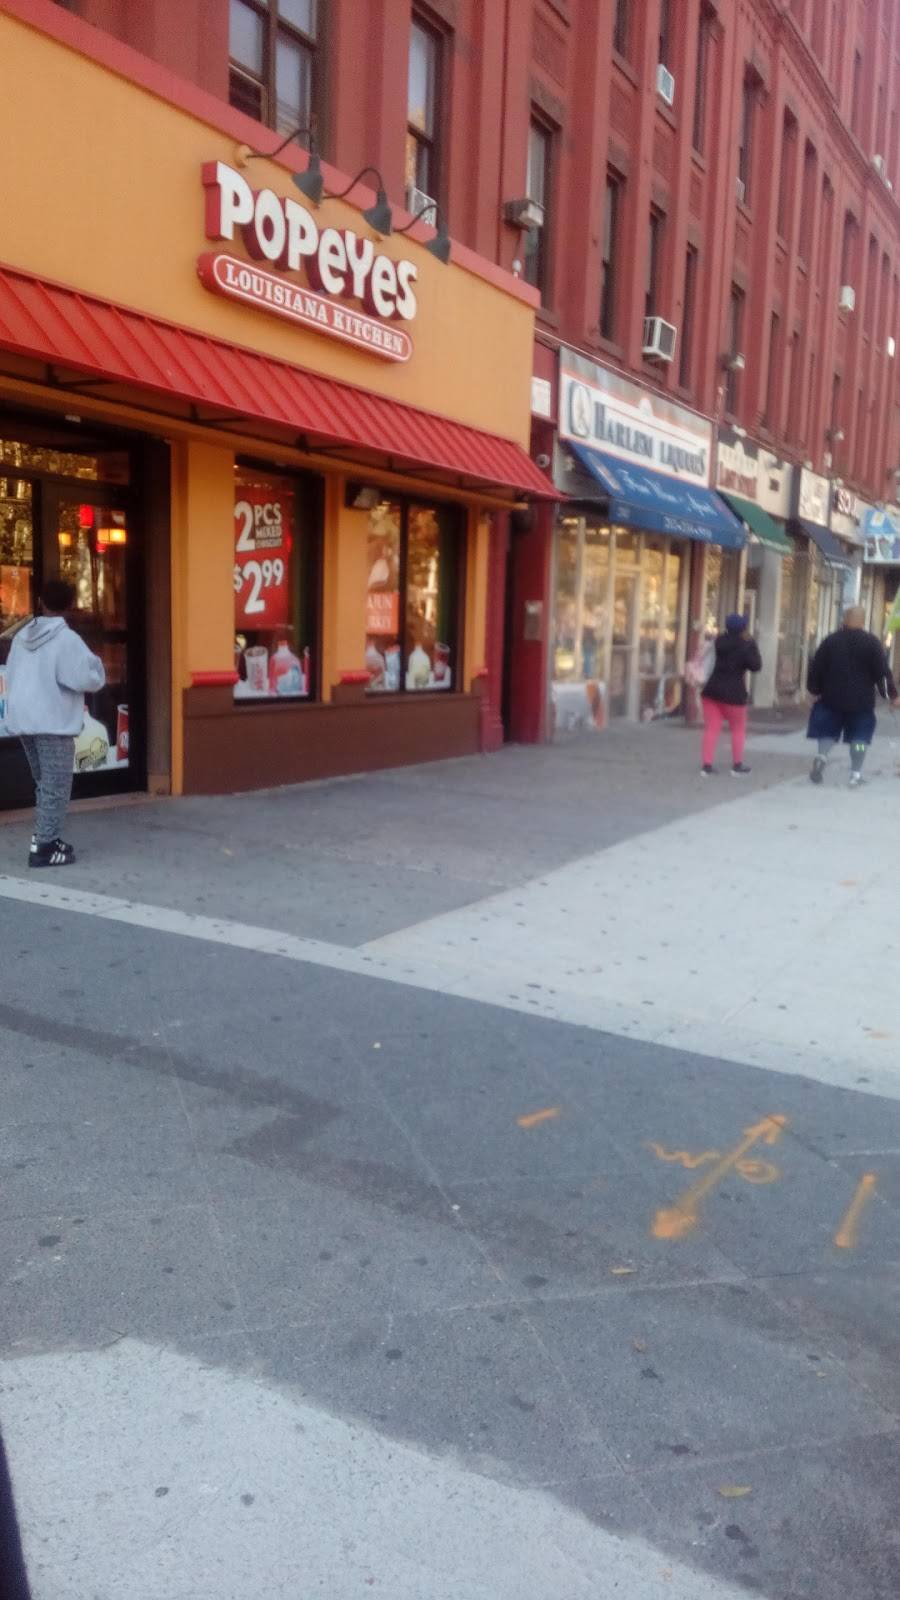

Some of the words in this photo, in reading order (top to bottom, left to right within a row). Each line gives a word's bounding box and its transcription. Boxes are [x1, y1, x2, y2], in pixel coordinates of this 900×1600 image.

[225, 263, 329, 324] LOUISIANA
[332, 310, 404, 355] KITCHEN
[234, 501, 256, 552] 2
[254, 503, 282, 525] PCS
